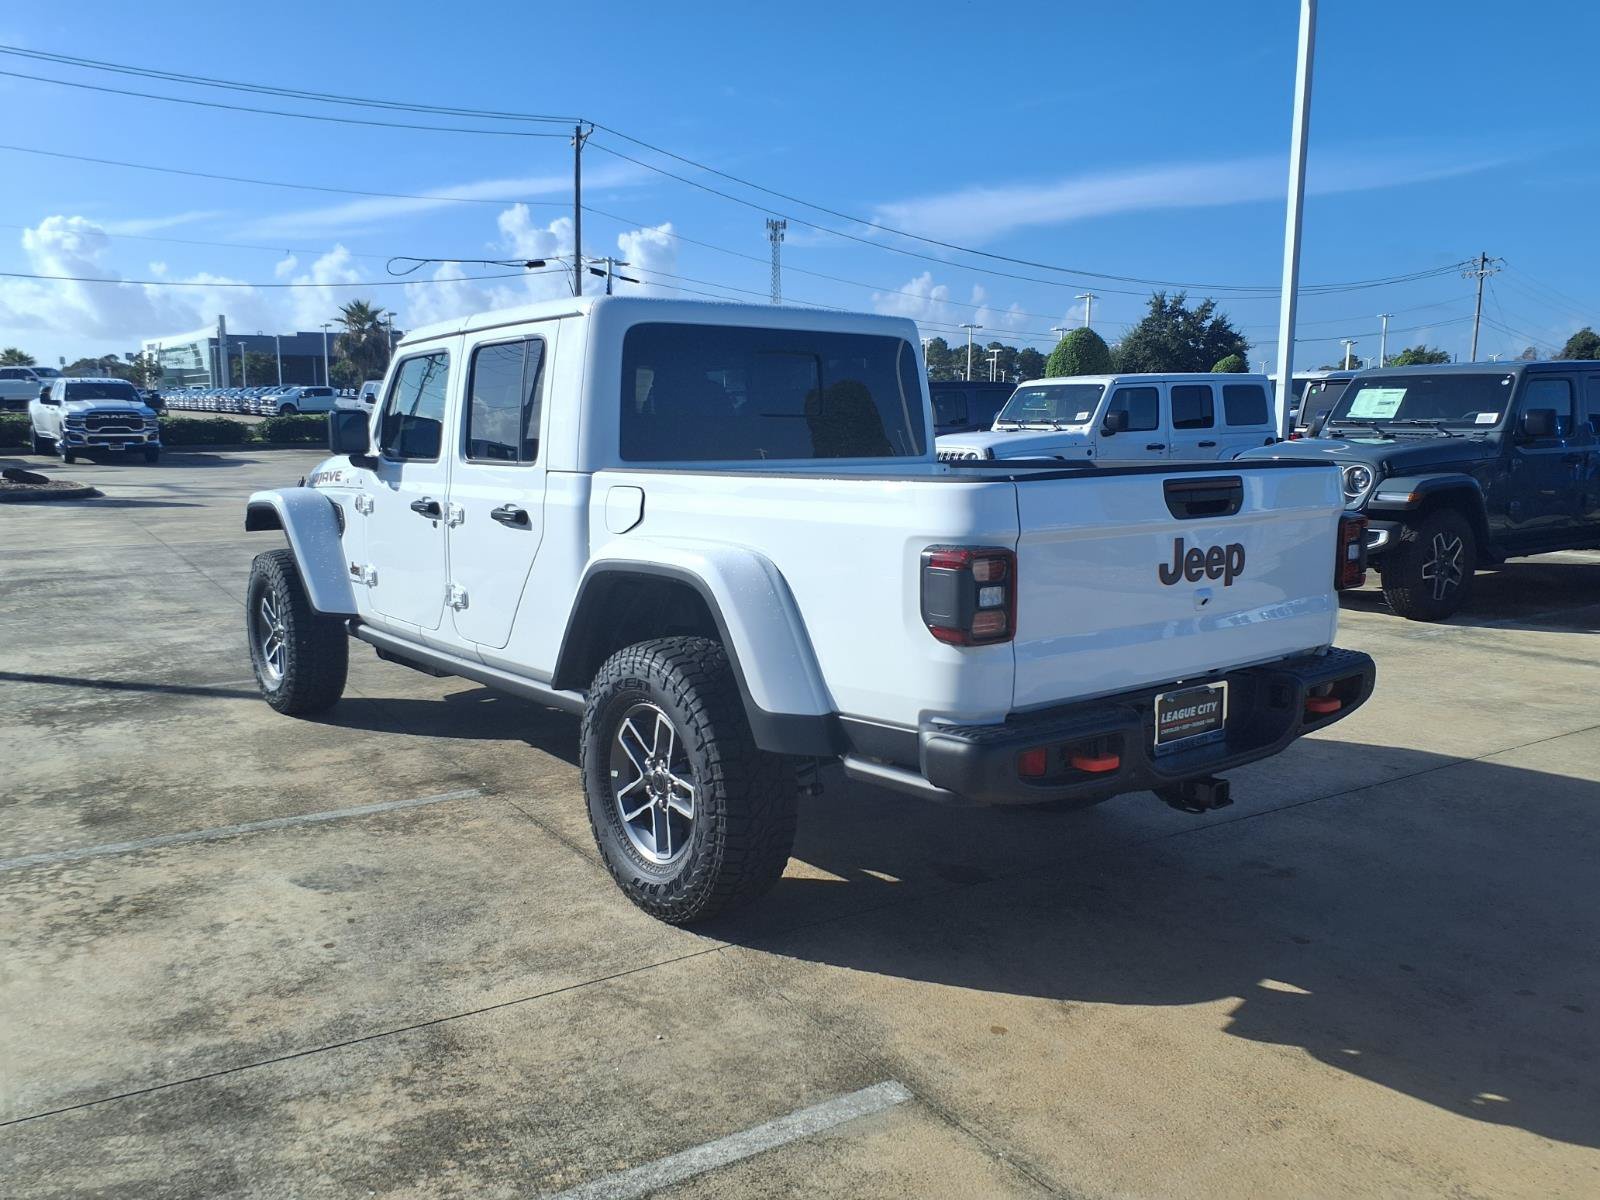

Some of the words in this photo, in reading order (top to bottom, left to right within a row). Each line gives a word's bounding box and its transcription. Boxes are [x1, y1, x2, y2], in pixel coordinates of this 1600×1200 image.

[1159, 537, 1246, 586] Jeep
[1161, 706, 1197, 723] LEAGUE
[1197, 701, 1218, 715] CITY
